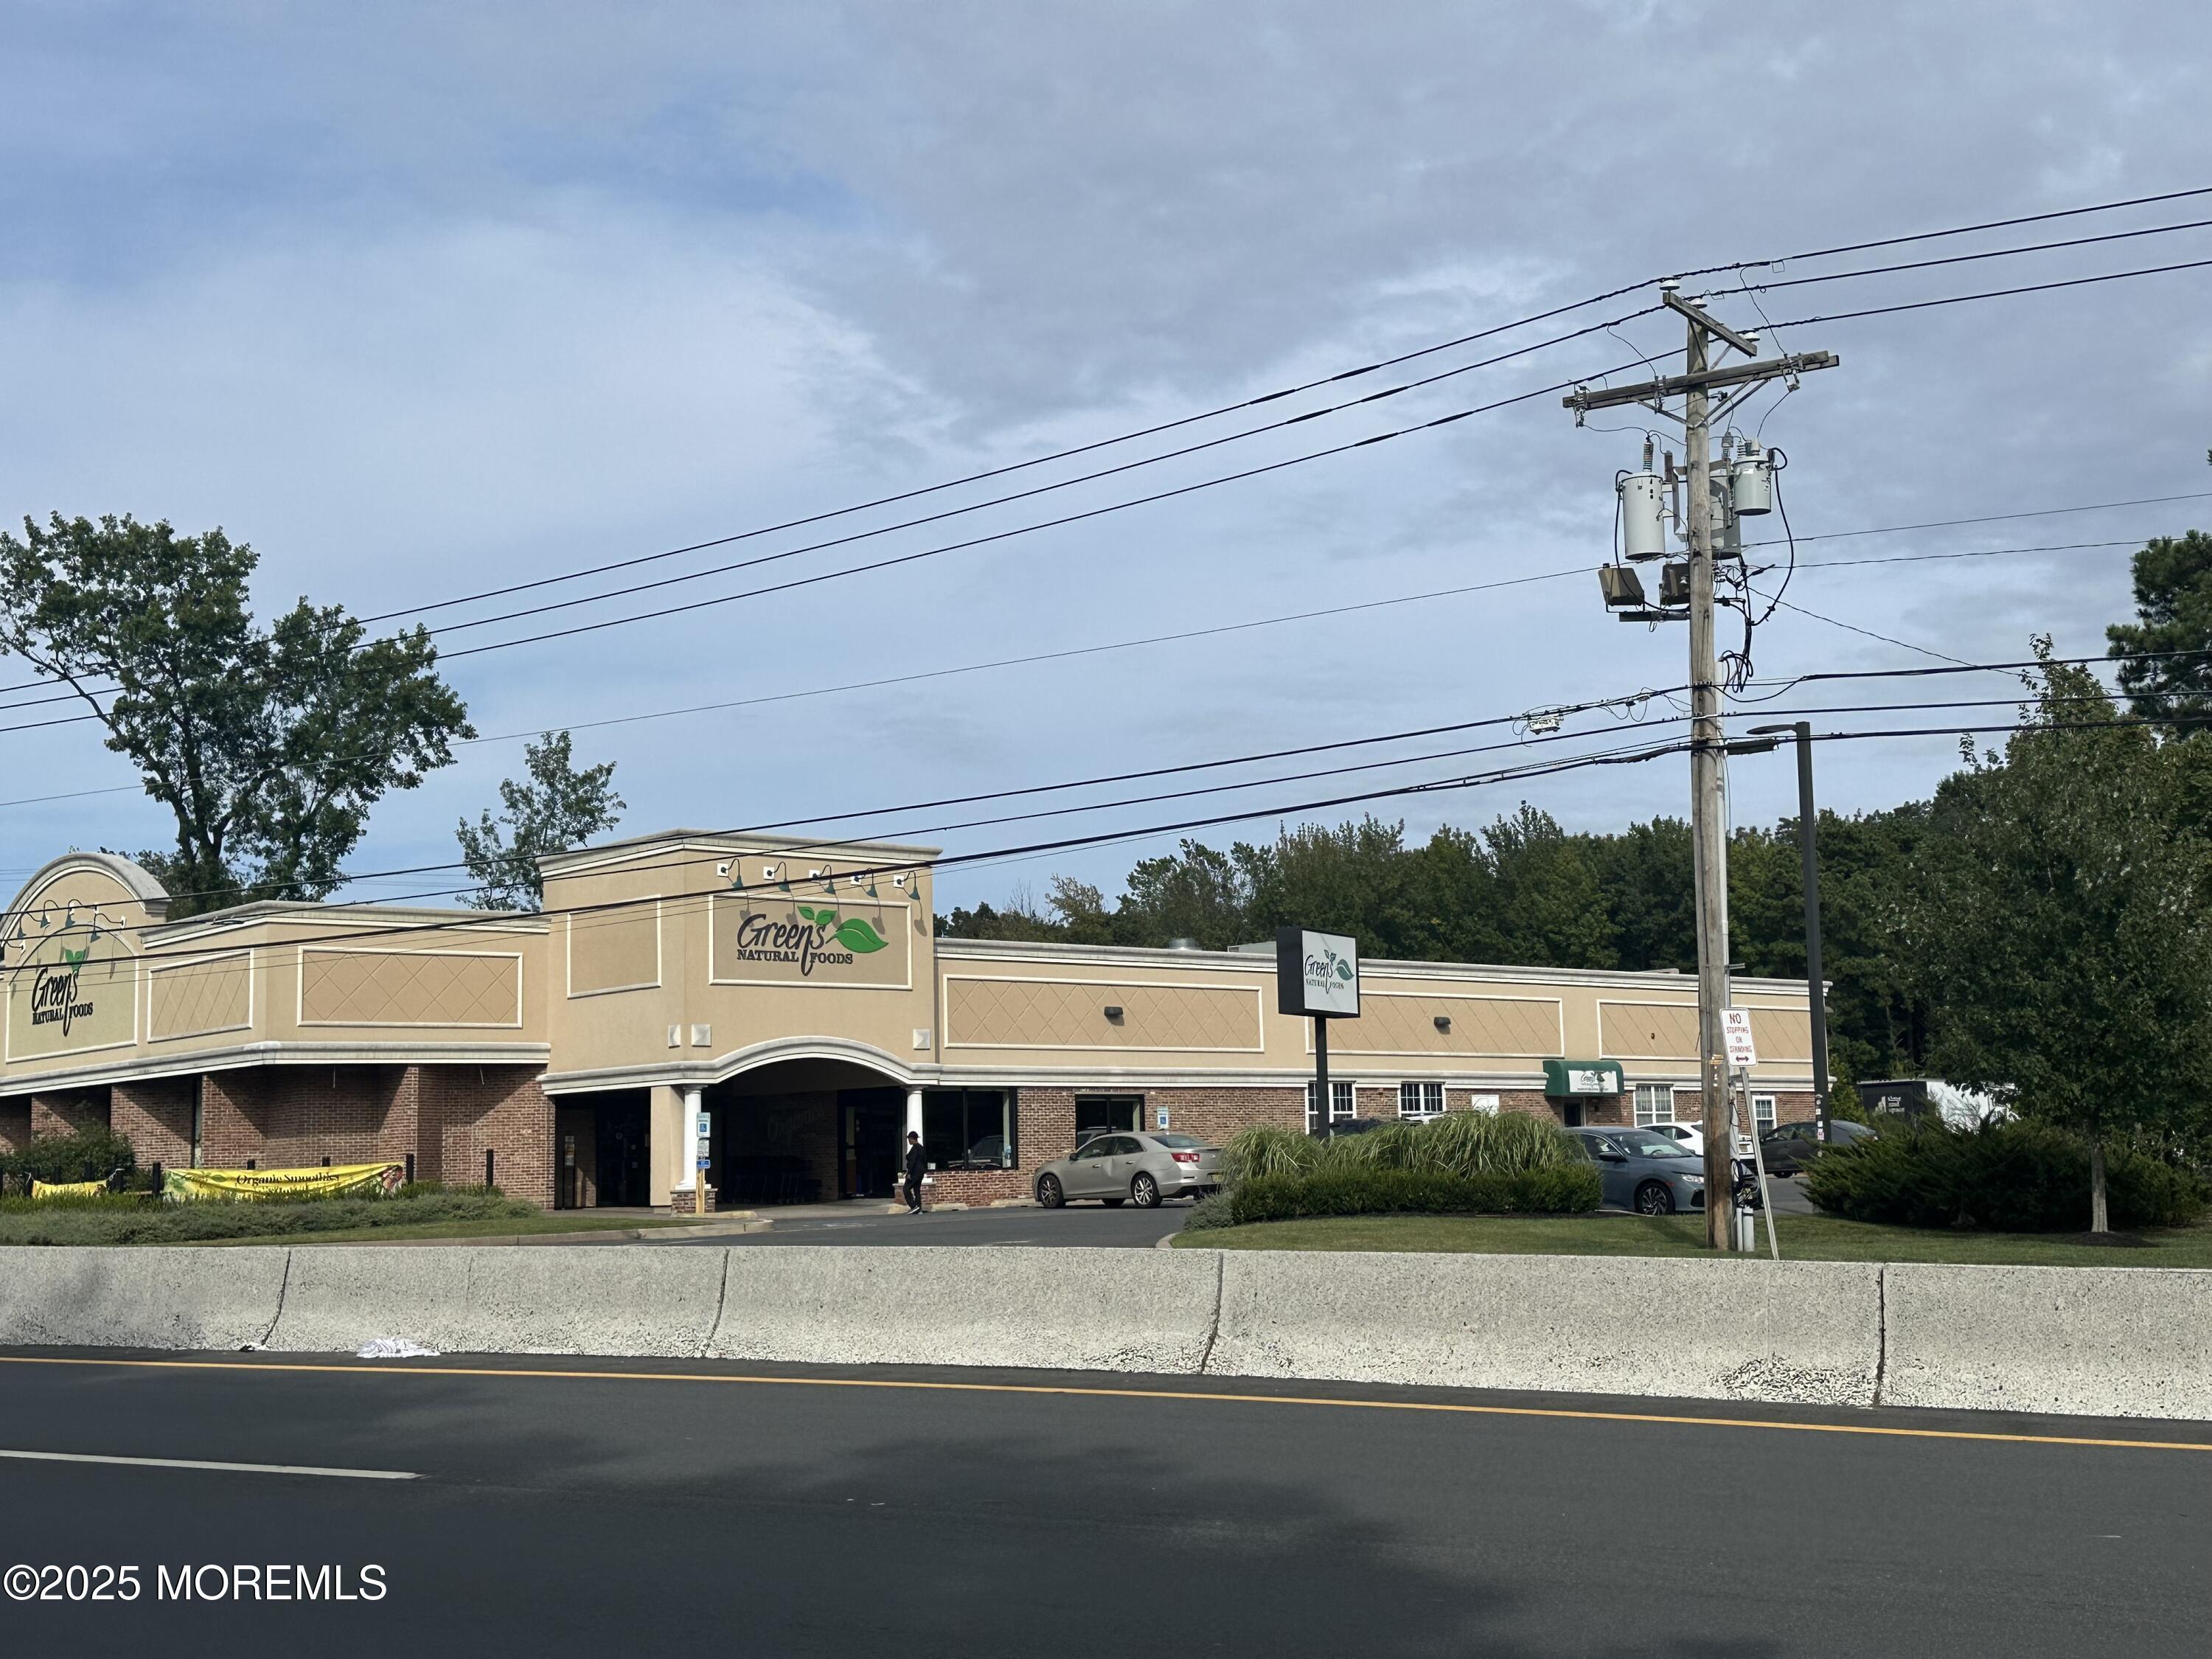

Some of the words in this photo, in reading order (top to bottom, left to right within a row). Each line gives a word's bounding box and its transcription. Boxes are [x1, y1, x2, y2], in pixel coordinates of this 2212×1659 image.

[737, 949, 799, 962] NATURAL
[809, 952, 853, 964] FOODS
[32, 1008, 63, 1025] NATURAL
[69, 1002, 93, 1018] FOODS
[1729, 1012, 1742, 1024] NO
